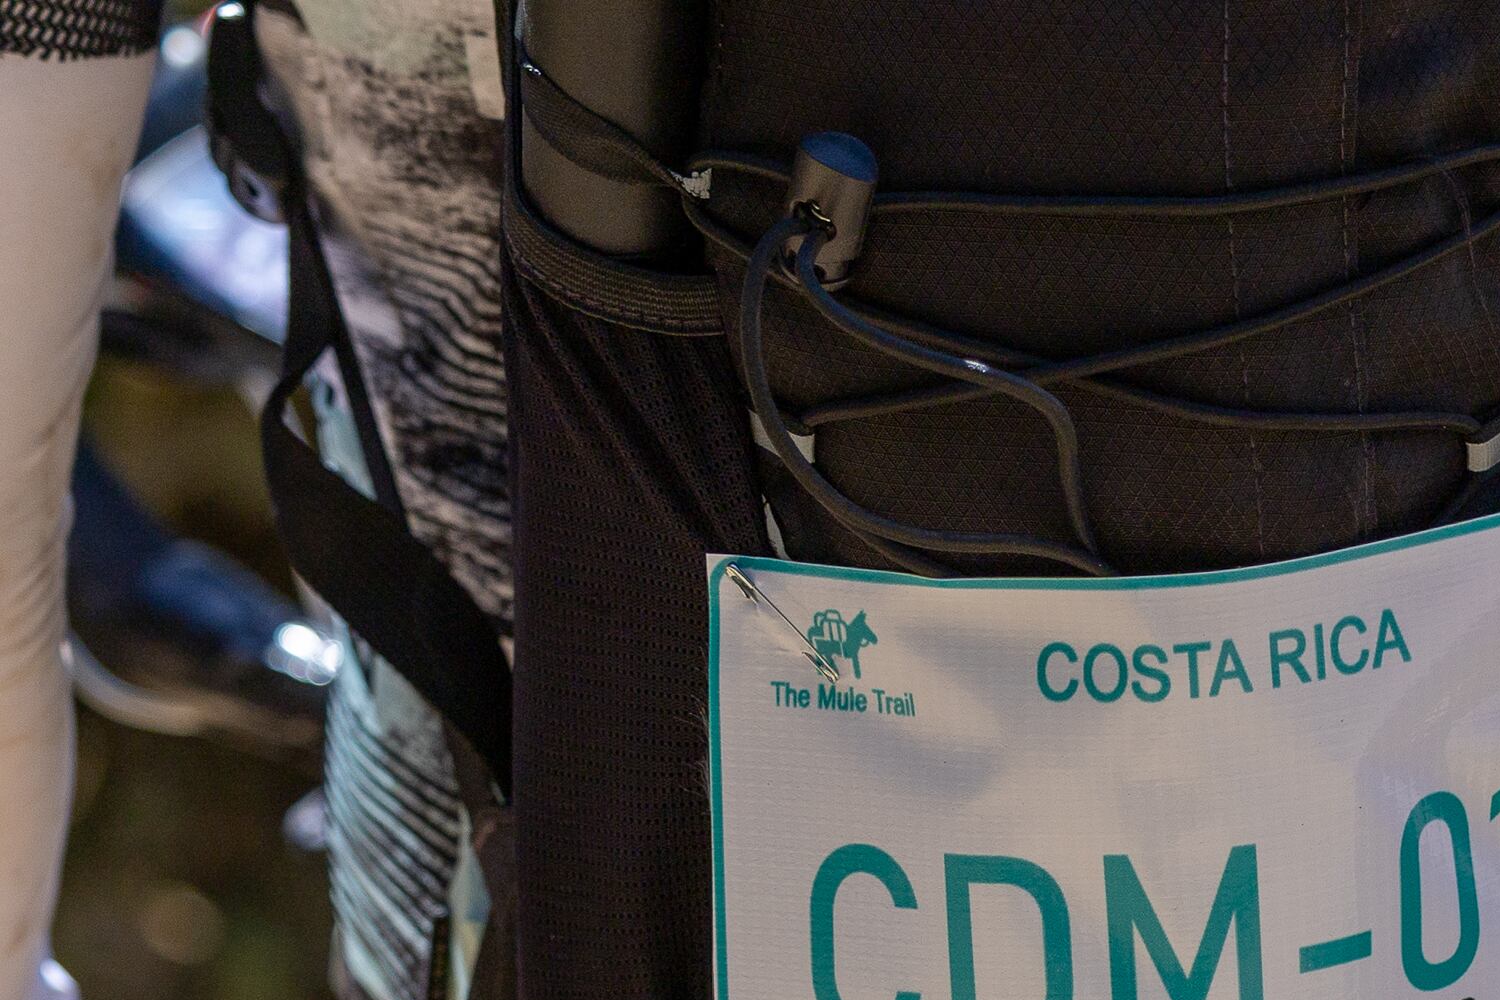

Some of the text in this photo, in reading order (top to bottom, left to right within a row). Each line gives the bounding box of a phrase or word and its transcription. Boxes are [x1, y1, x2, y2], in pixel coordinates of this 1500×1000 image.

[1036, 607, 1412, 704] COSTA RICA
[771, 681, 916, 718] The Mule Trail
